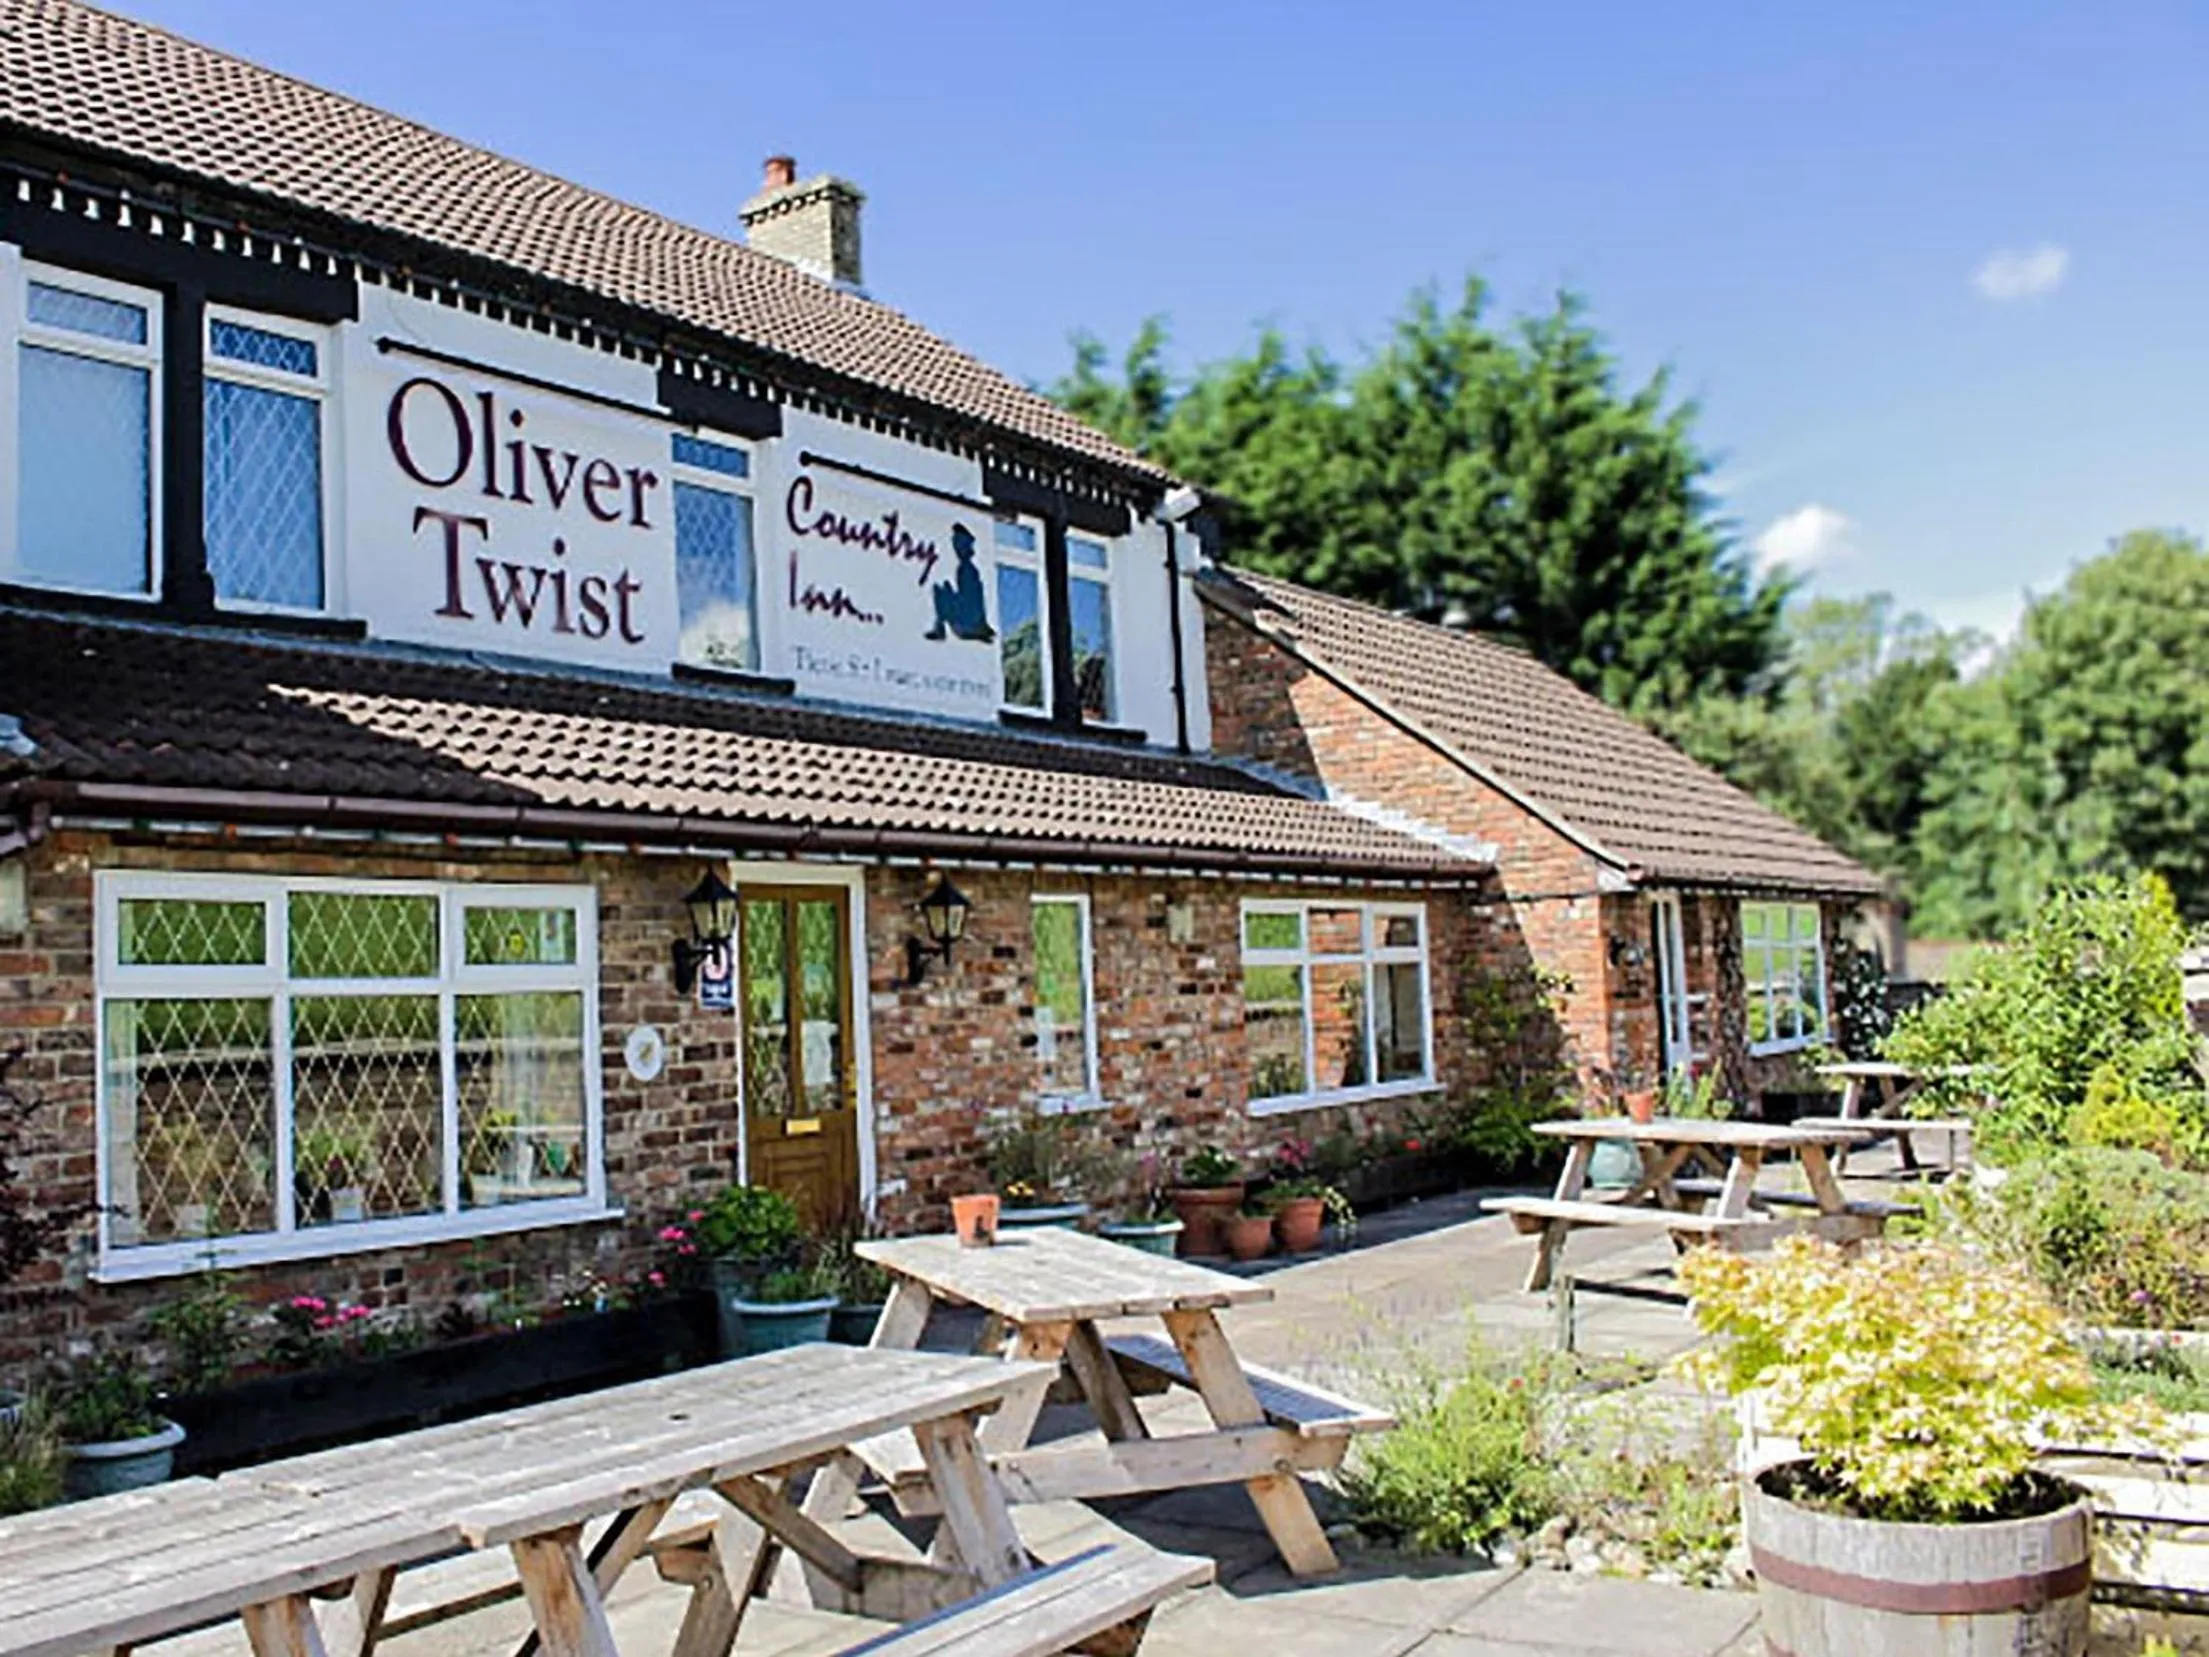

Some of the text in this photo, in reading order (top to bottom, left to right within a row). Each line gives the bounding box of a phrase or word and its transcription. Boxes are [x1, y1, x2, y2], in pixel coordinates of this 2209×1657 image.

[388, 377, 658, 529] Oliver
[413, 507, 645, 645] Twist
[788, 476, 939, 585] Country
